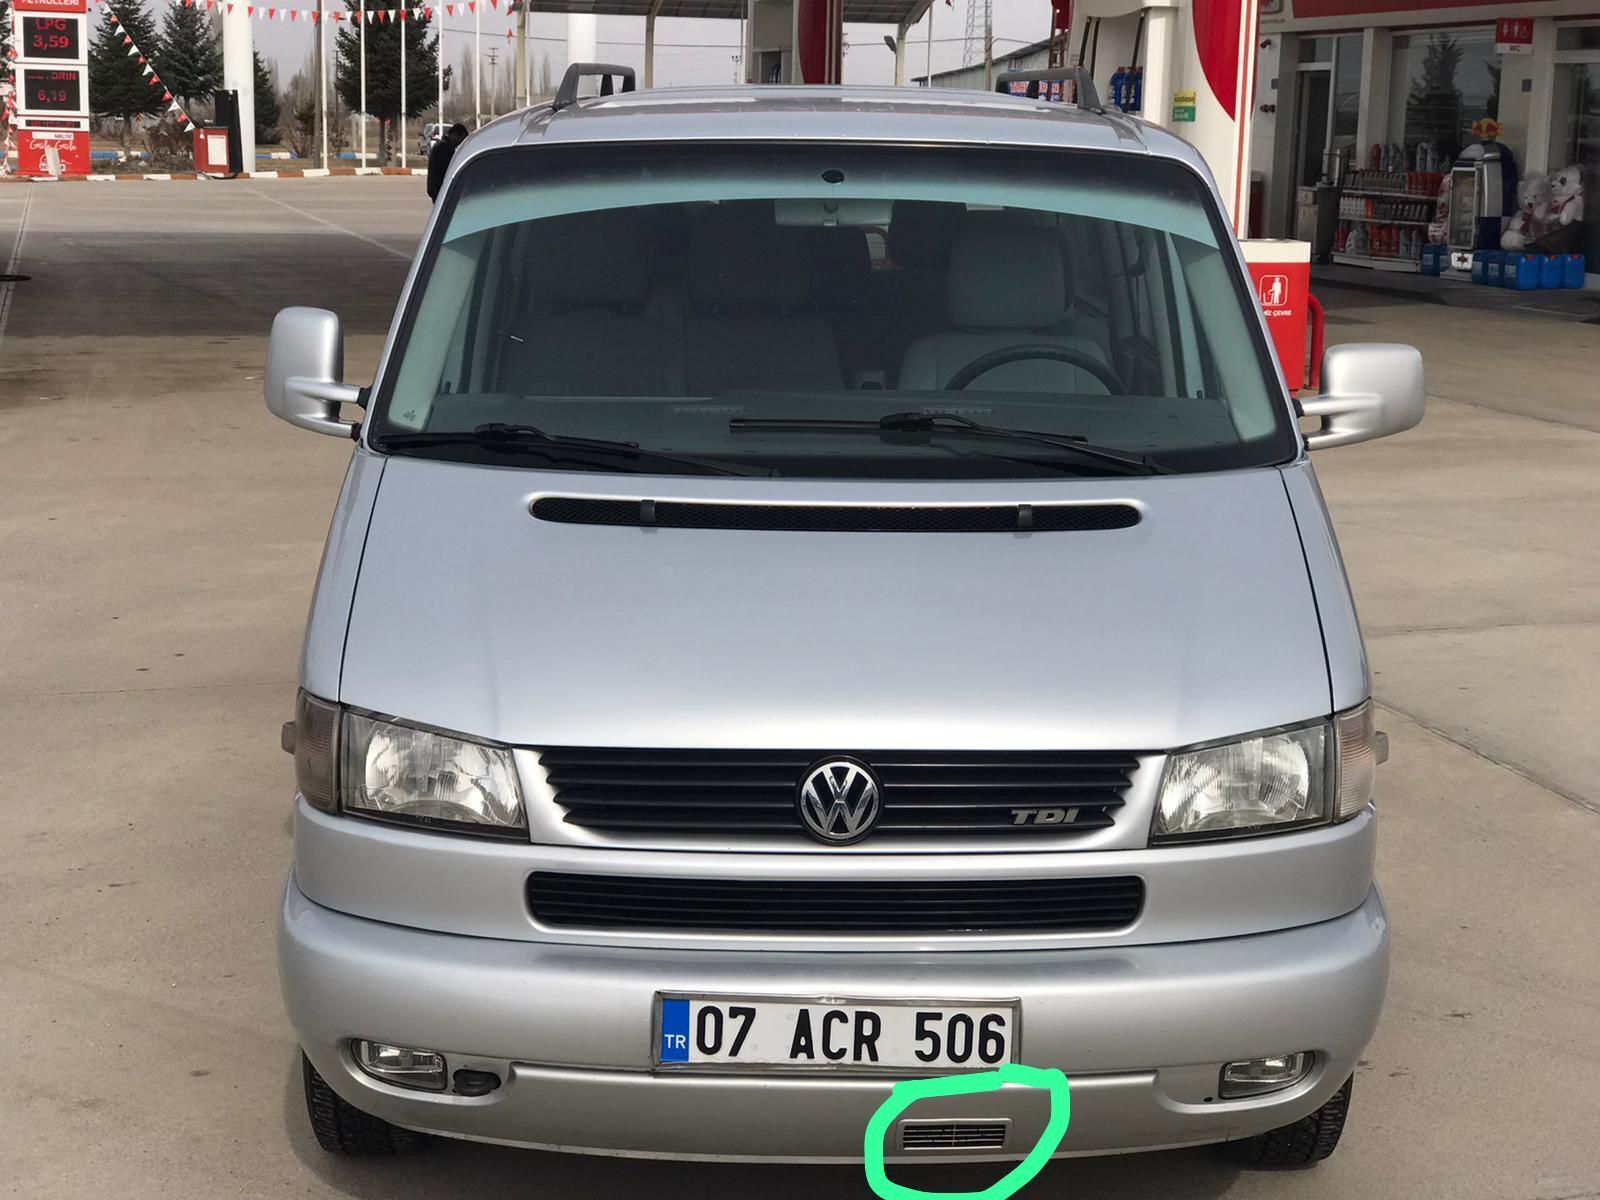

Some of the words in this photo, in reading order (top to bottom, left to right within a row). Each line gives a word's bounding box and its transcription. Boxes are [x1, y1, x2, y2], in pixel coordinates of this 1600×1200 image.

[35, 18, 67, 31] LPG
[33, 34, 70, 50] 3,59
[1011, 808, 1080, 825] TDI
[664, 1034, 687, 1050] TR
[696, 1005, 757, 1057] 07
[789, 1008, 882, 1062] ACR
[914, 1011, 1006, 1064] 506
